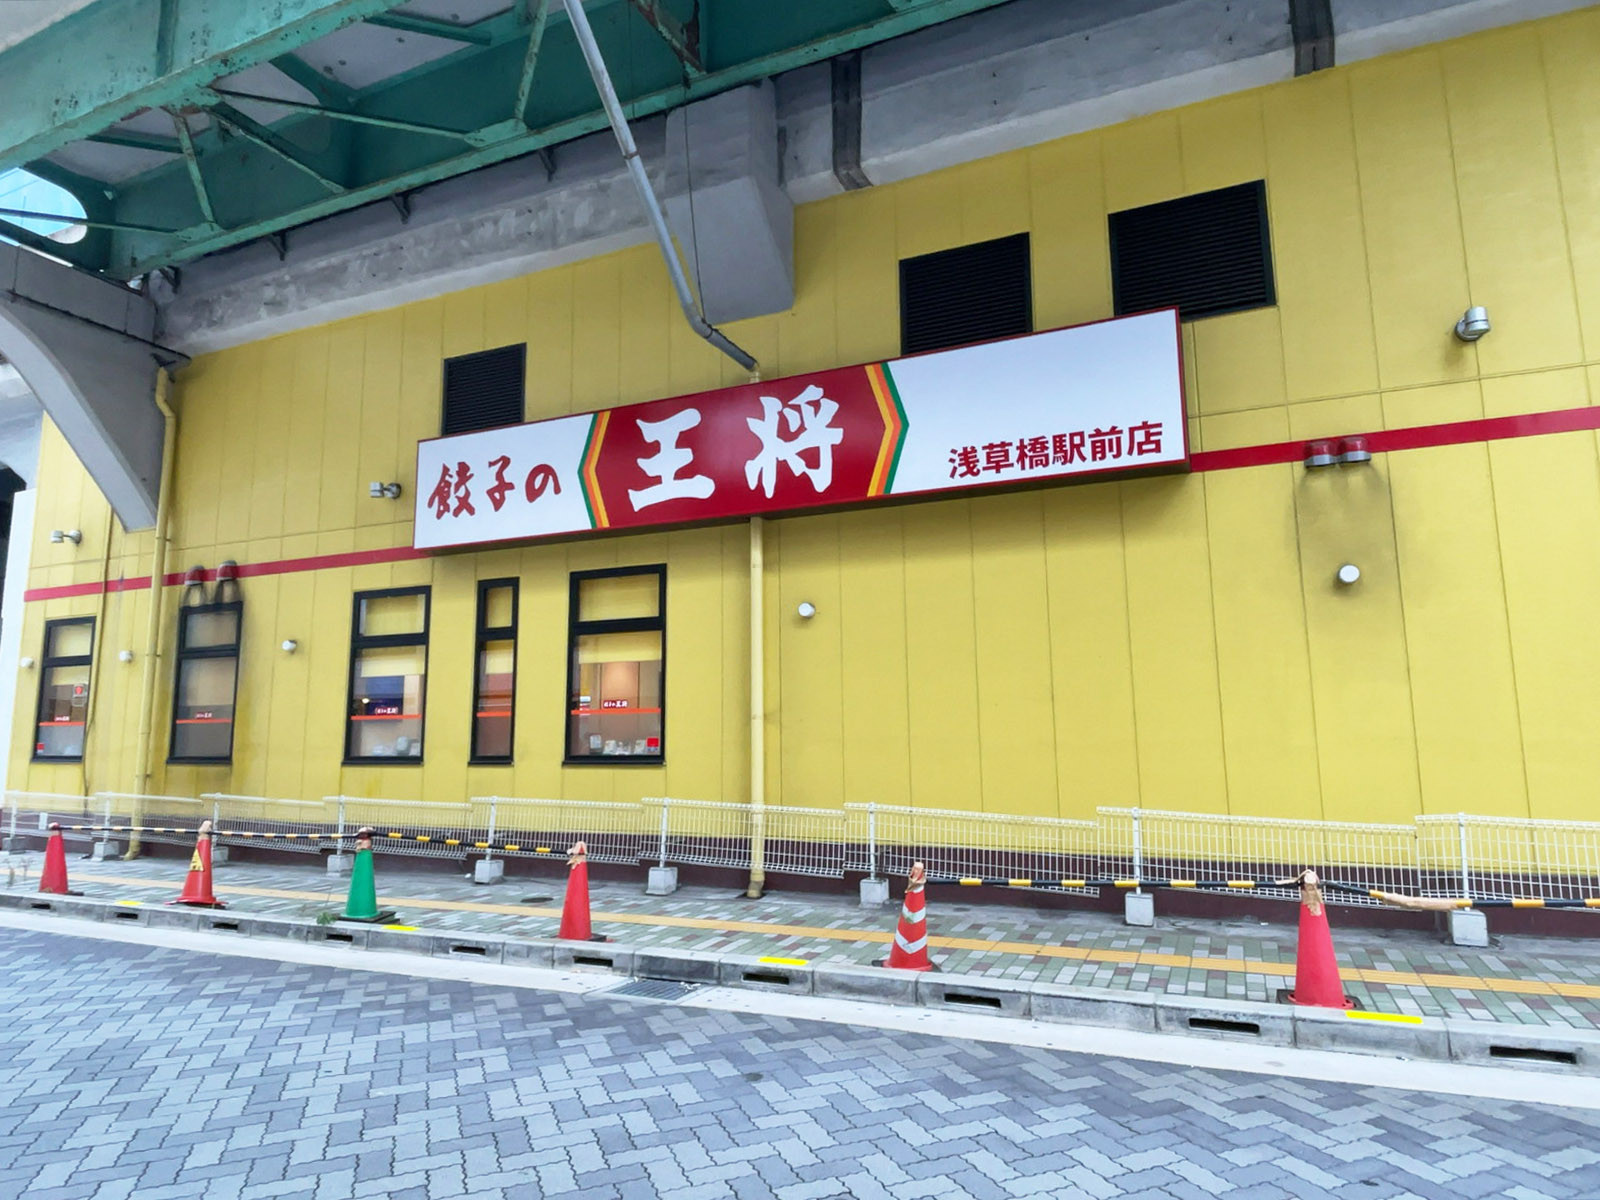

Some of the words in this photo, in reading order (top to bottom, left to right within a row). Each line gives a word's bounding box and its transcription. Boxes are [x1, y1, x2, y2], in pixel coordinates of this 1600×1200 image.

[428, 456, 561, 519] 餃子の
[628, 385, 844, 511] 王将
[949, 421, 1162, 479] 浅草橋駅前店
